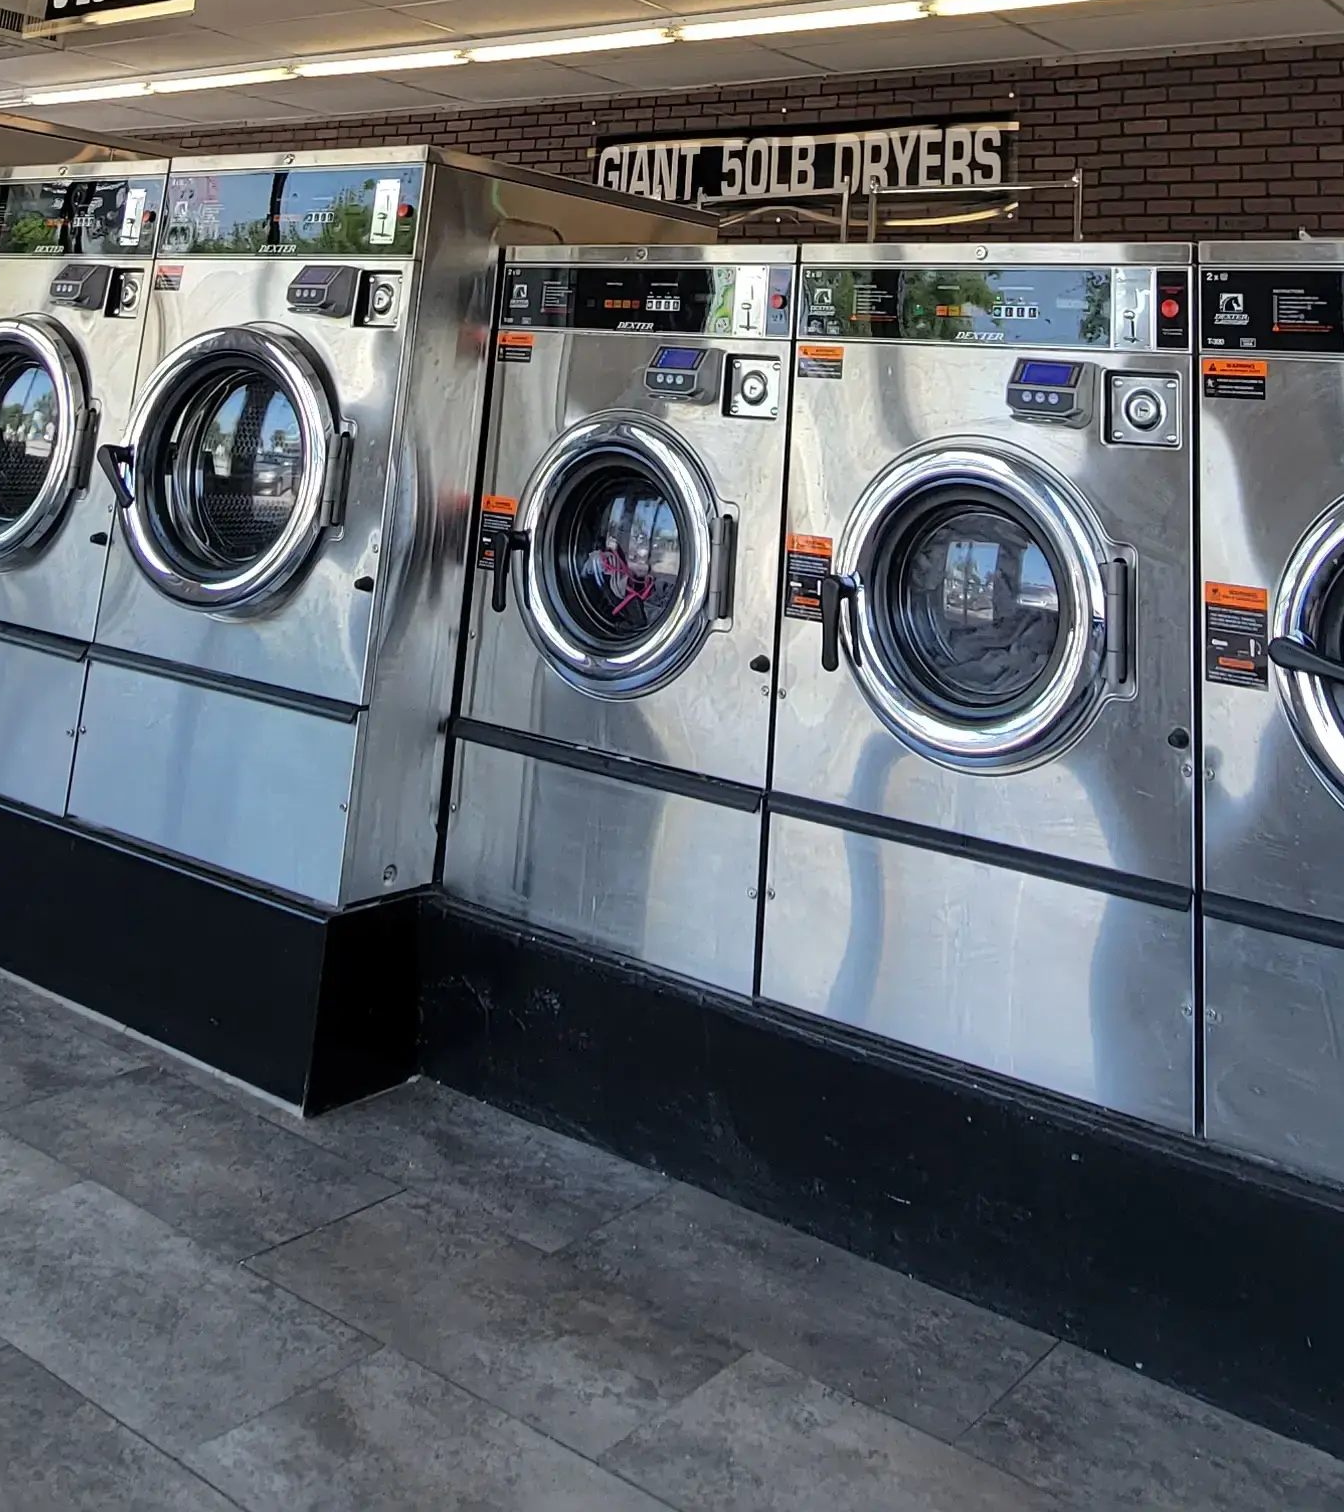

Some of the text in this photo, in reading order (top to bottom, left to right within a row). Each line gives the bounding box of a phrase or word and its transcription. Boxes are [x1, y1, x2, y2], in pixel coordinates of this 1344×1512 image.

[598, 126, 1002, 201] GIANT 50LB DRYERS
[258, 244, 297, 253] DEXTER
[1206, 272, 1213, 281] 2
[617, 321, 654, 330] DEXTER
[955, 331, 1005, 341] DEXTER
